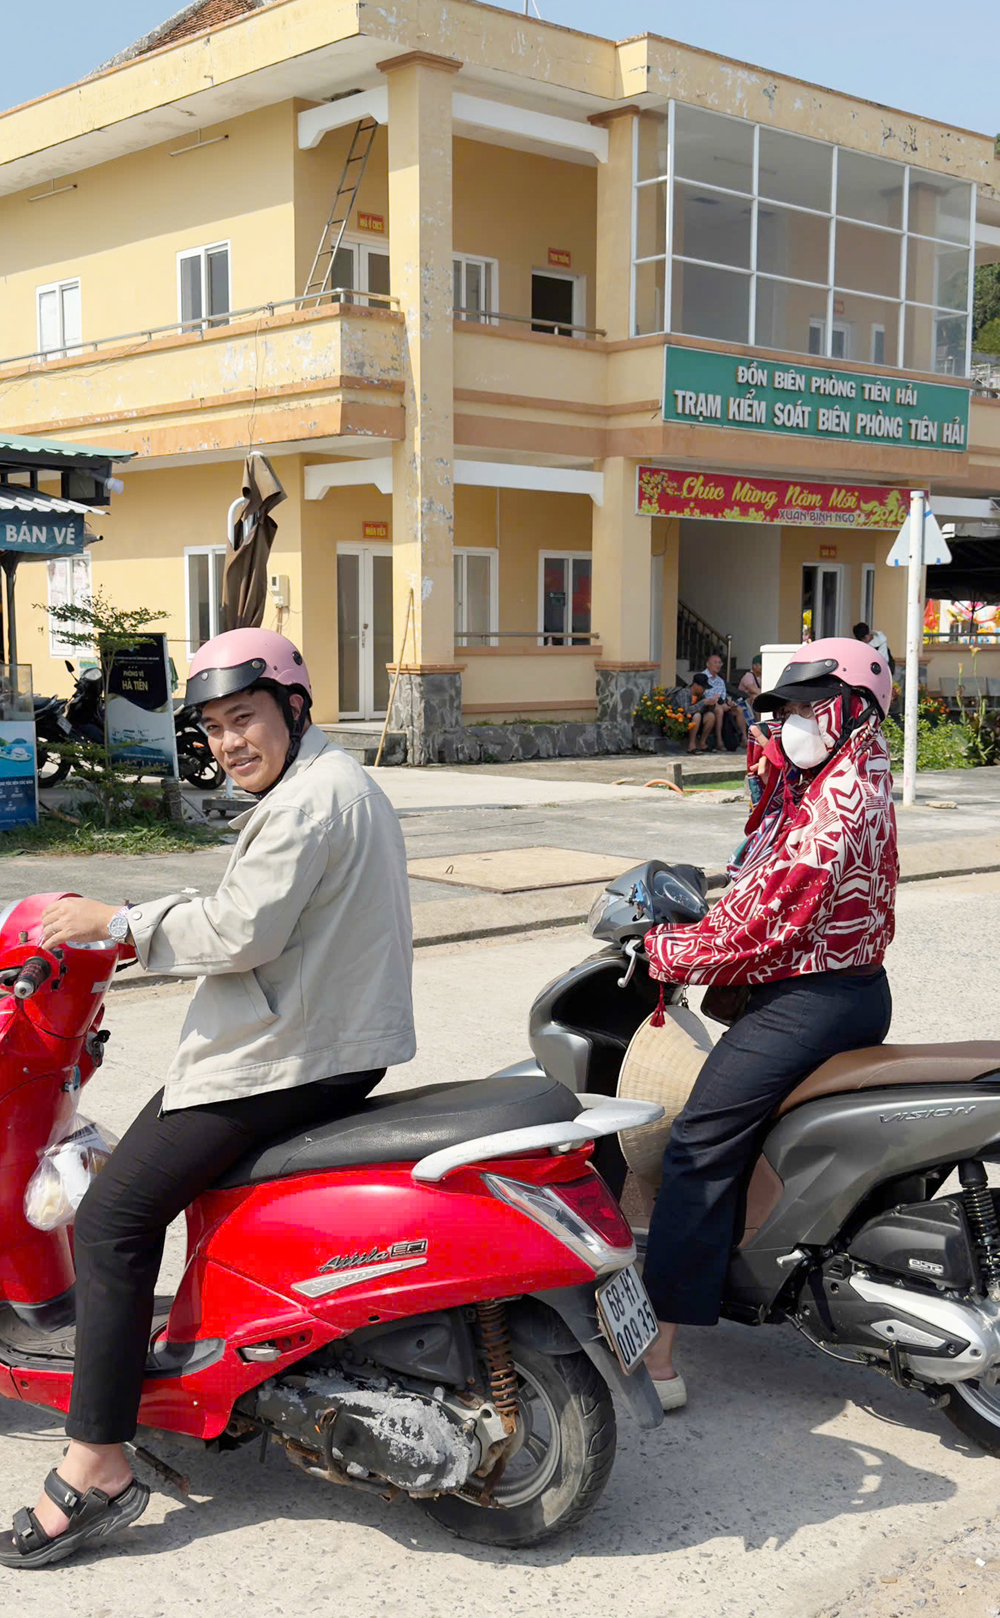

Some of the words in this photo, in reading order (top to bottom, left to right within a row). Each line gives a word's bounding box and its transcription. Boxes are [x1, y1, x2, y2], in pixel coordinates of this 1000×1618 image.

[737, 361, 768, 387] ĐỒN
[774, 369, 805, 392] BIÊN
[811, 374, 856, 399] PHÒNG
[862, 381, 891, 402] TIÊN
[896, 383, 917, 406] HẢI
[673, 389, 721, 421] TRẠM
[727, 388, 767, 424] KIỂM
[773, 400, 812, 428] SOÁT
[818, 405, 850, 434] BIÊN
[856, 409, 903, 439] PHÒNG
[909, 415, 938, 442] TIÊN
[942, 416, 965, 444] HẢI
[682, 474, 725, 500] Chúc
[784, 484, 822, 507] Năm
[828, 487, 859, 509] Mới
[779, 507, 807, 520] XUÂN
[809, 508, 833, 522] BÍNH
[871, 505, 907, 523] 2026
[5, 520, 47, 543] BÁN
[53, 523, 76, 545] VÉ
[122, 678, 133, 690] HÀ
[133, 678, 148, 691] TIÊN
[879, 1105, 976, 1123] VISION
[605, 1268, 640, 1322] 68-H1
